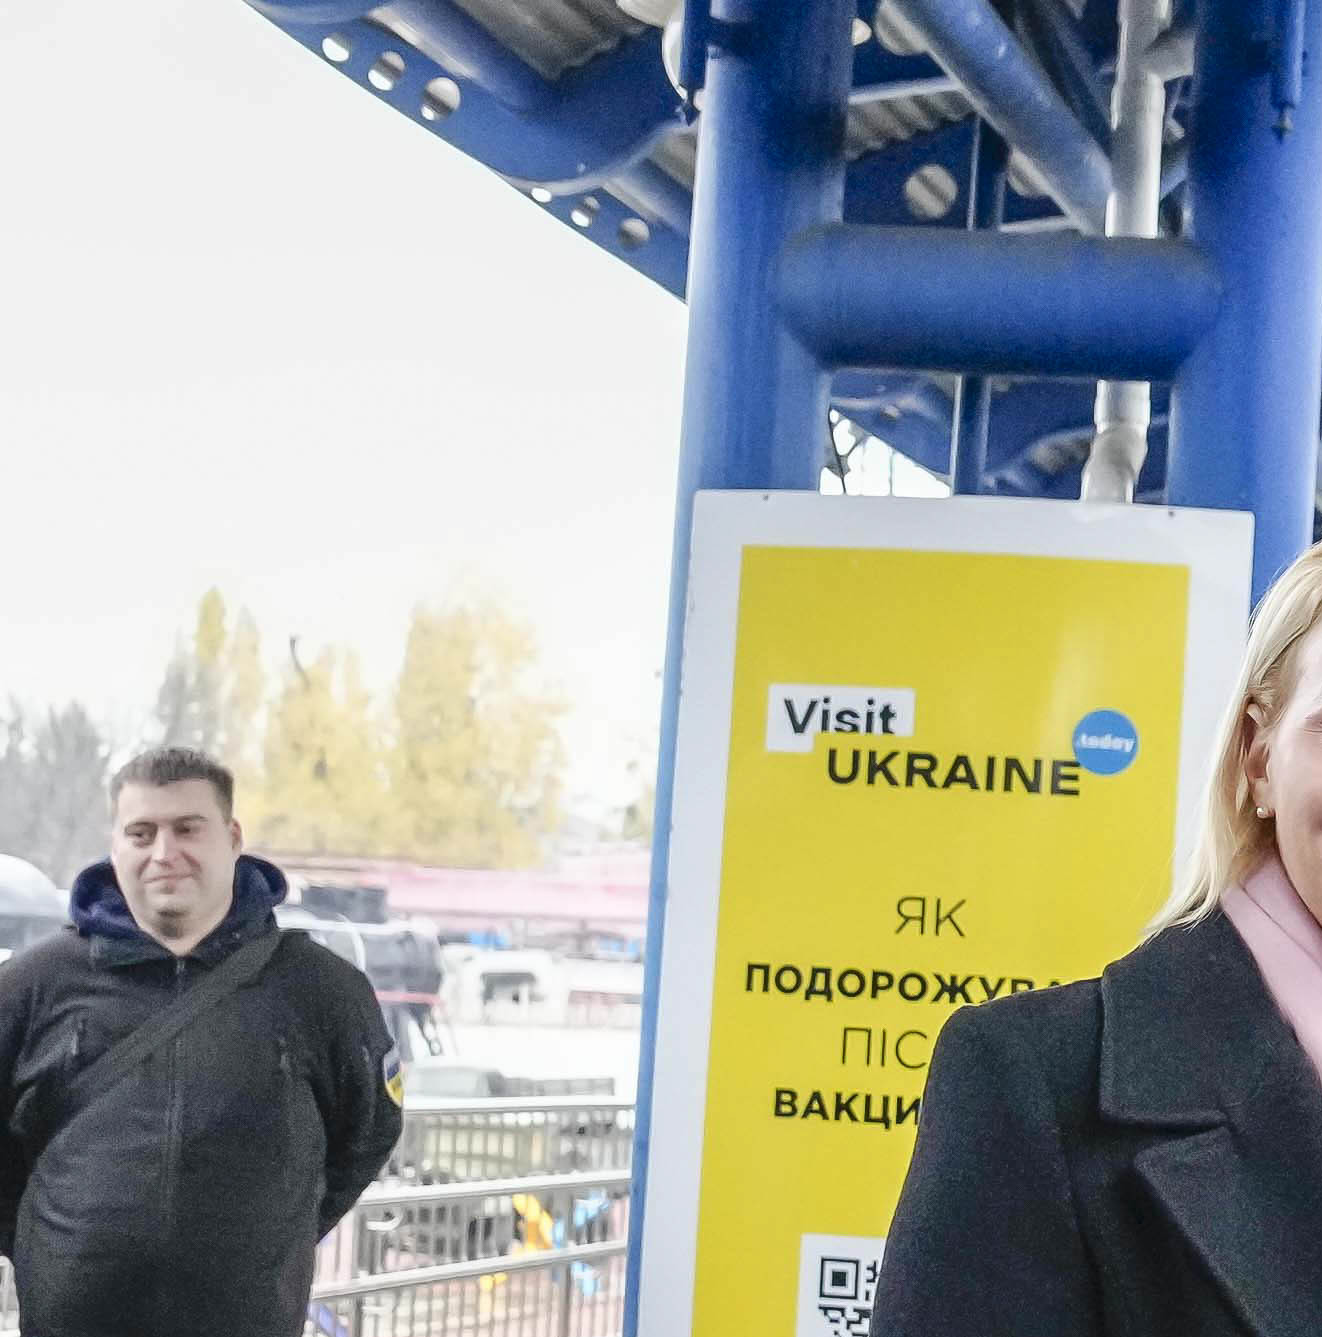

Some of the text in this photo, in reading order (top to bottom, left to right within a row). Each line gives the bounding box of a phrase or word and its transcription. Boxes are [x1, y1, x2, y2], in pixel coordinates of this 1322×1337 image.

[783, 698, 898, 735] Visit
[826, 749, 1081, 796] UKRAINE
[893, 897, 967, 938] ЯК
[745, 962, 1060, 1003] ПОДОРОЖУ
[773, 1088, 921, 1129] ВАКЦИ
